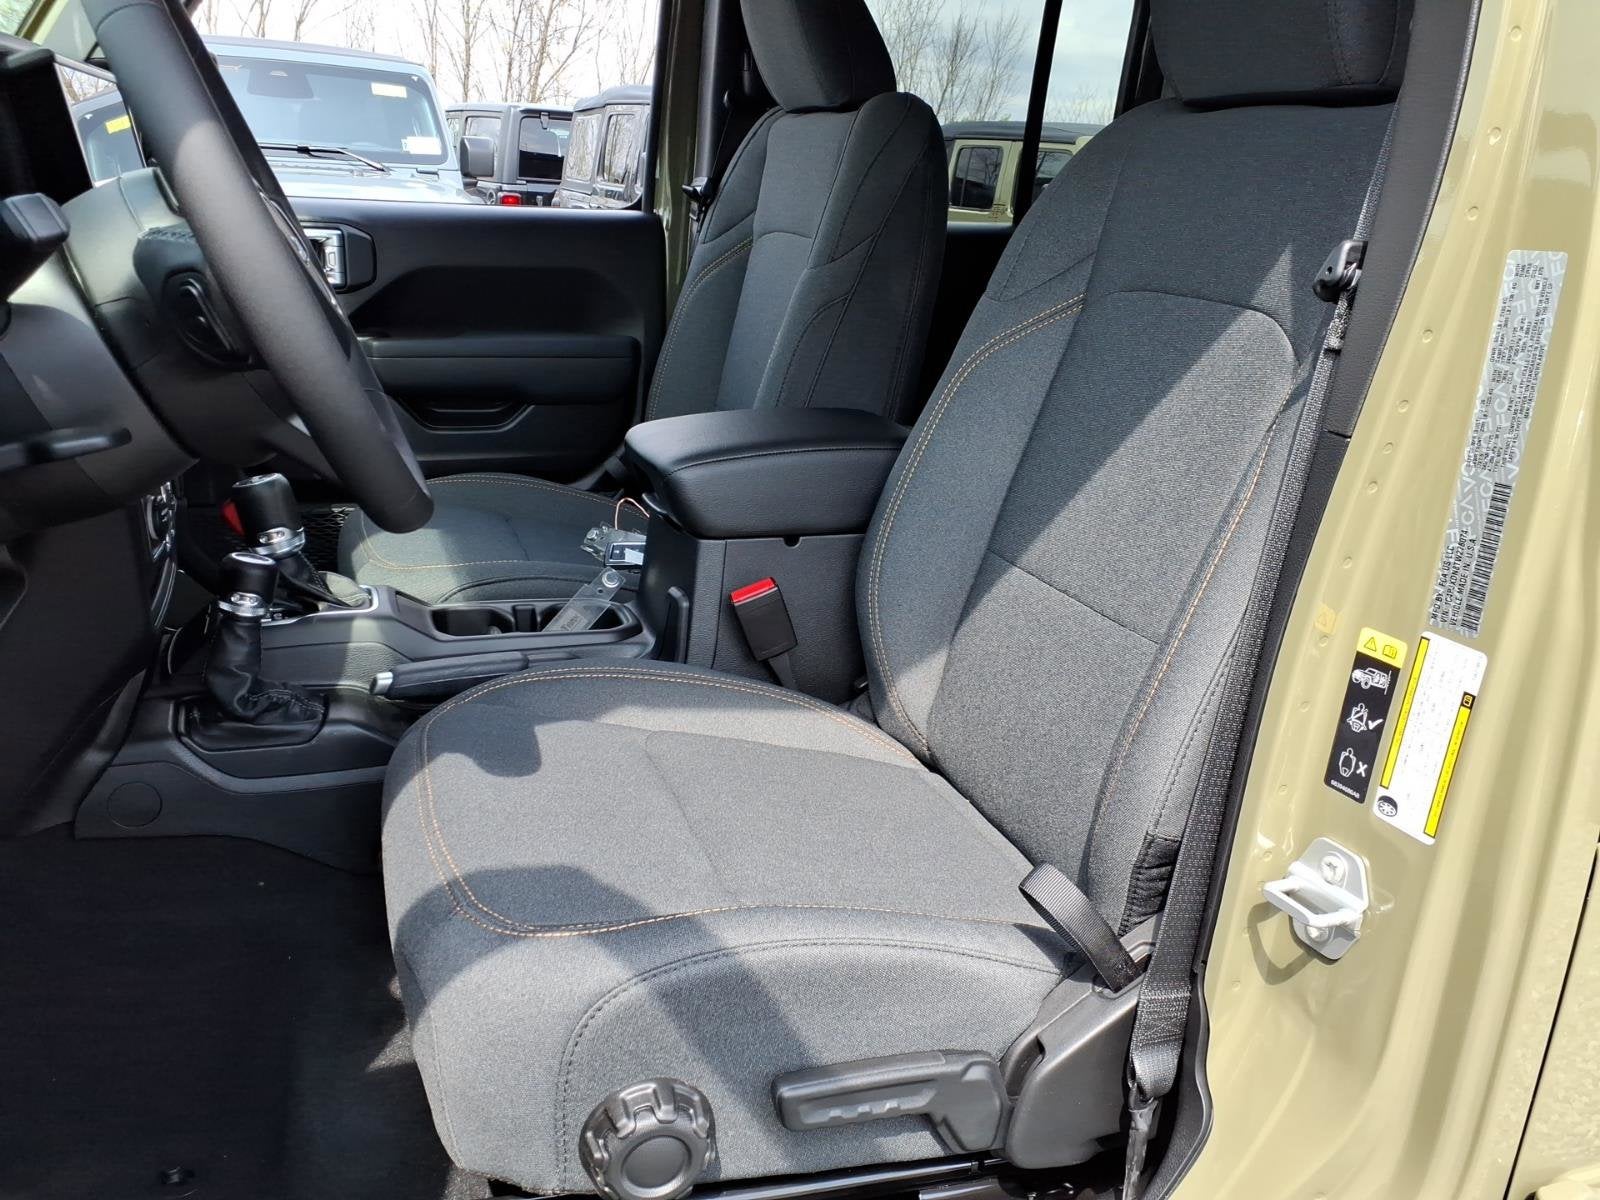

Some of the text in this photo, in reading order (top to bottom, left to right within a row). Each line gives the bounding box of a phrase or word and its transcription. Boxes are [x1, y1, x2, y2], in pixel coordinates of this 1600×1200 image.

[1446, 544, 1455, 559] LLC
[1443, 559, 1451, 571] US
[1440, 572, 1448, 586] FCA
[1450, 596, 1462, 626] VEHICLE
[1457, 573, 1468, 595] MADE
